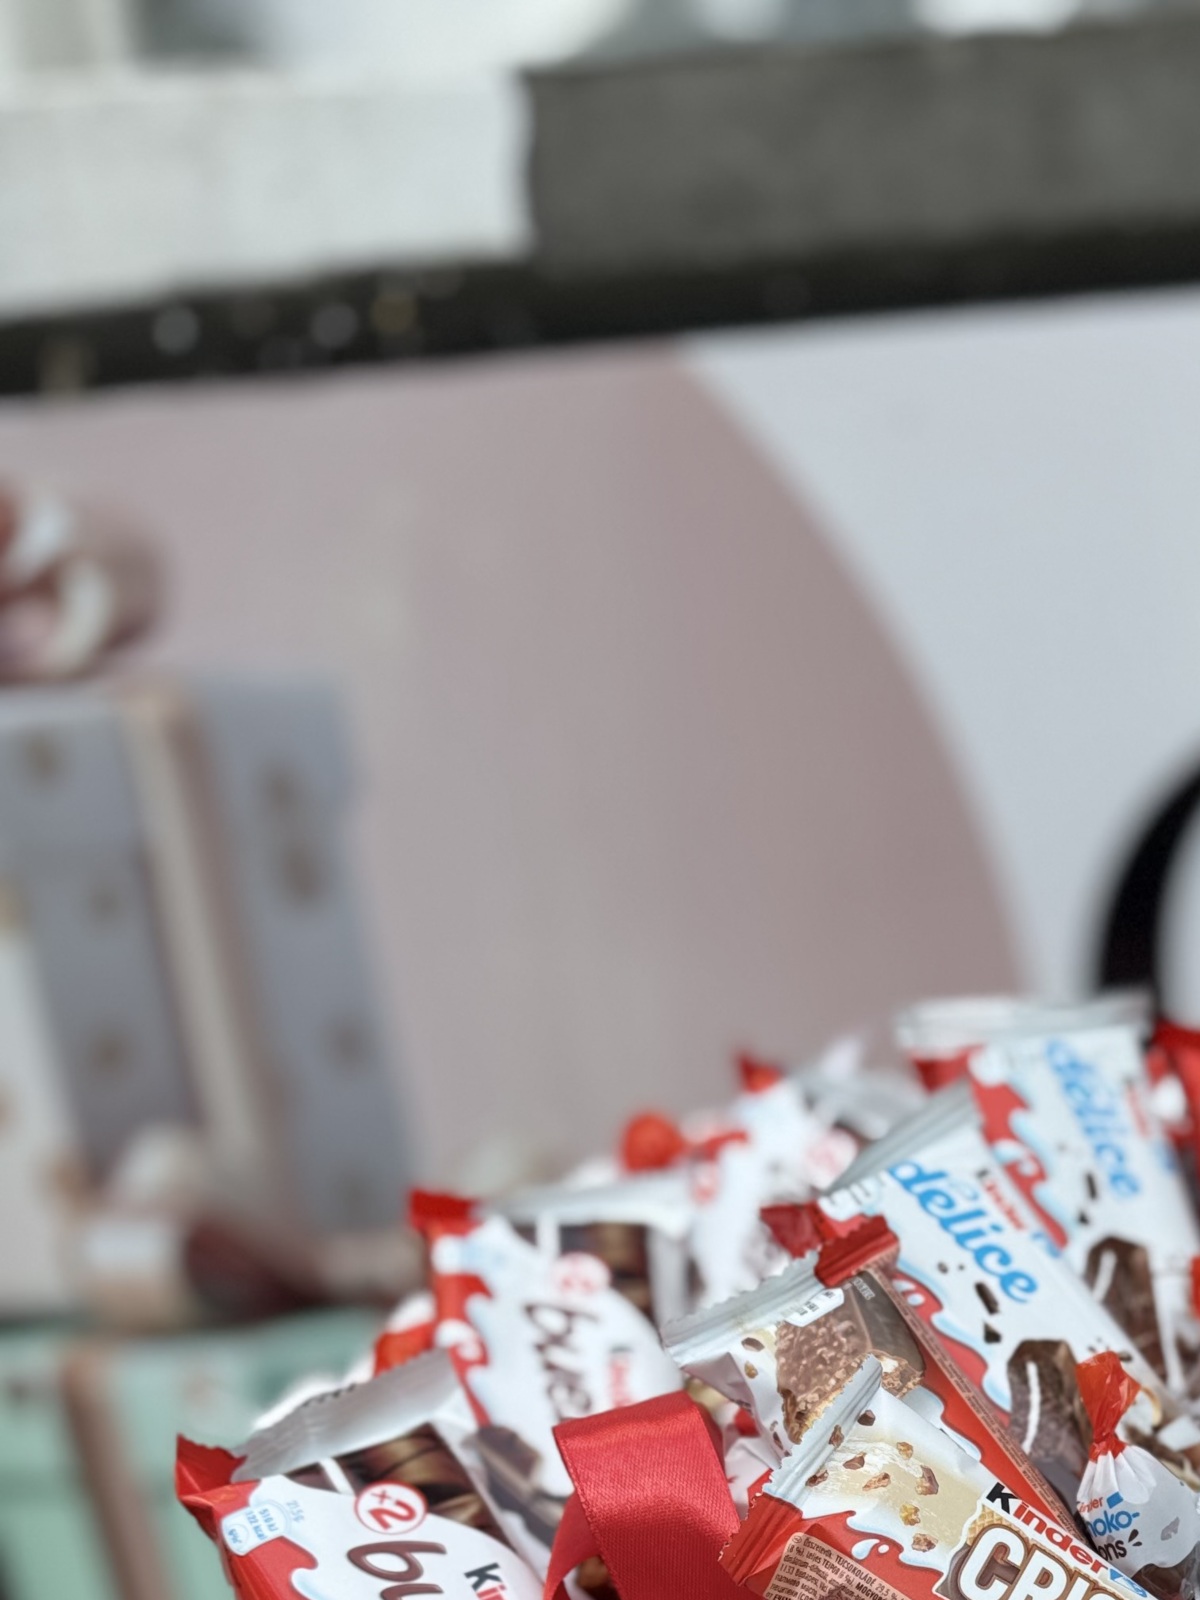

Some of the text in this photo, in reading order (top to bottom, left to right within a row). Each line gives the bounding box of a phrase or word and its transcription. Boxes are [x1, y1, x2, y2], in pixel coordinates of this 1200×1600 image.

[524, 1301, 598, 1418] bue
[986, 1481, 1109, 1581] Kinder
[1098, 1539, 1128, 1562] ons
